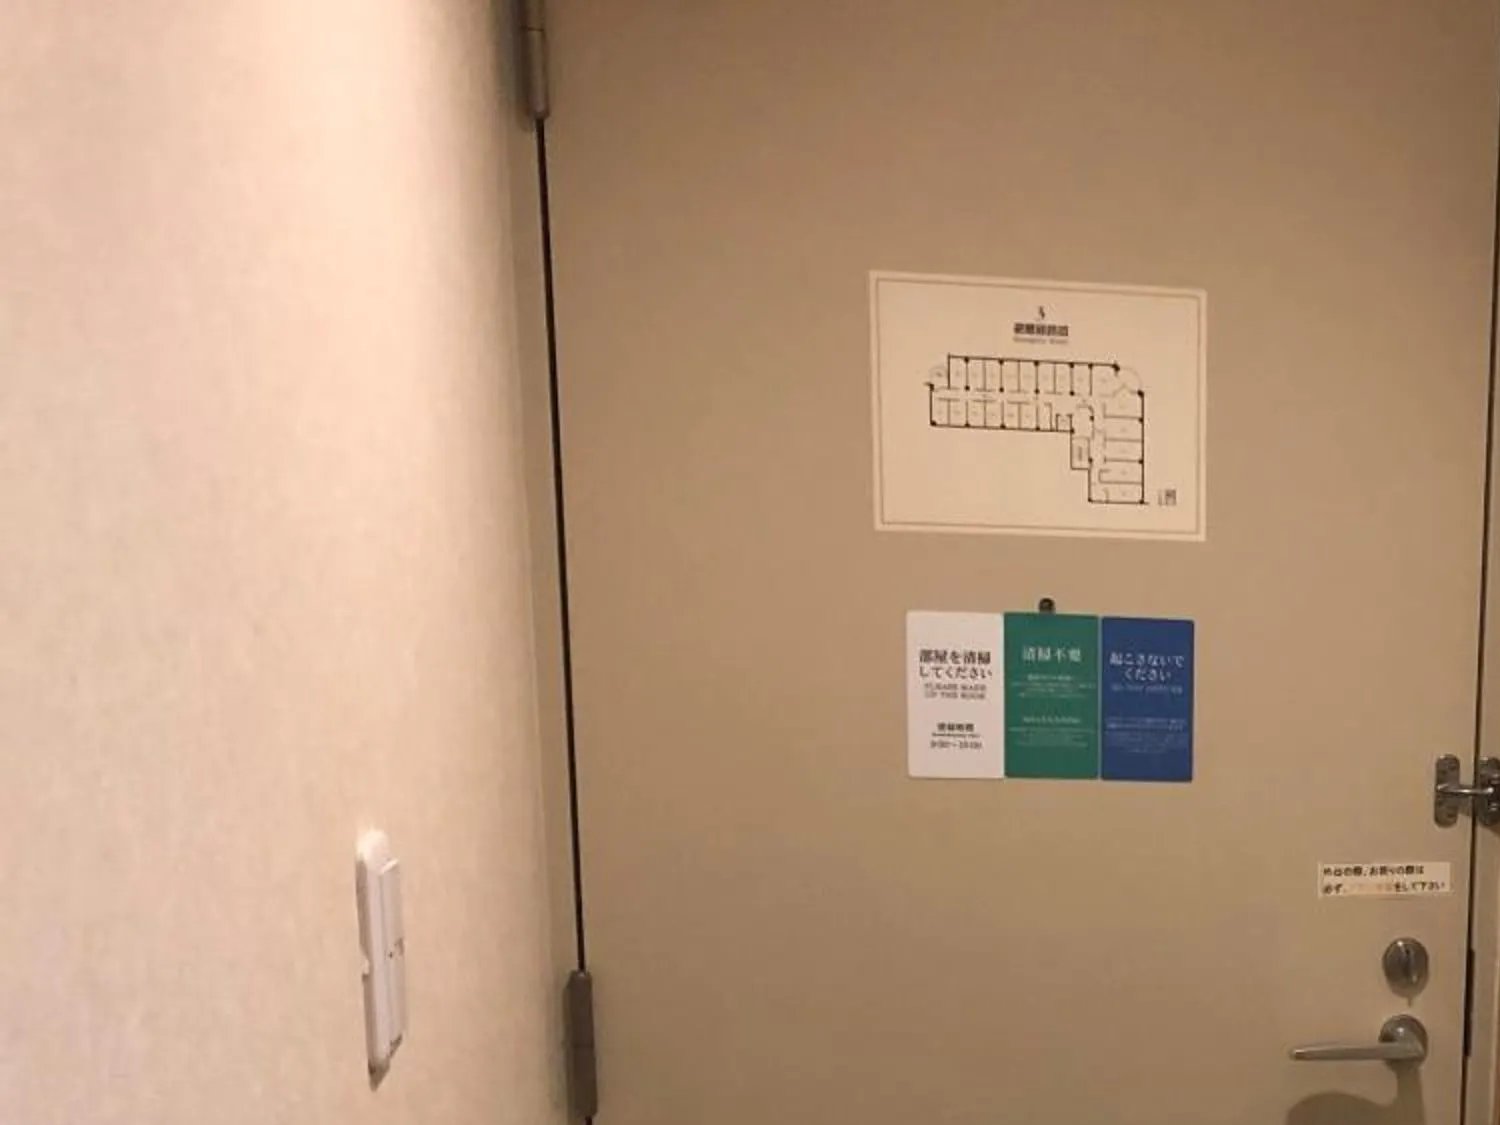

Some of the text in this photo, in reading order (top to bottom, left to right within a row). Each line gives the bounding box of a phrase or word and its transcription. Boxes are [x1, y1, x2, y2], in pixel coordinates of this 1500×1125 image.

[919, 649, 991, 665] 部屋を清掃
[1109, 651, 1185, 668] 起こさないで
[919, 666, 993, 680] してください
[1124, 668, 1172, 682] ください
